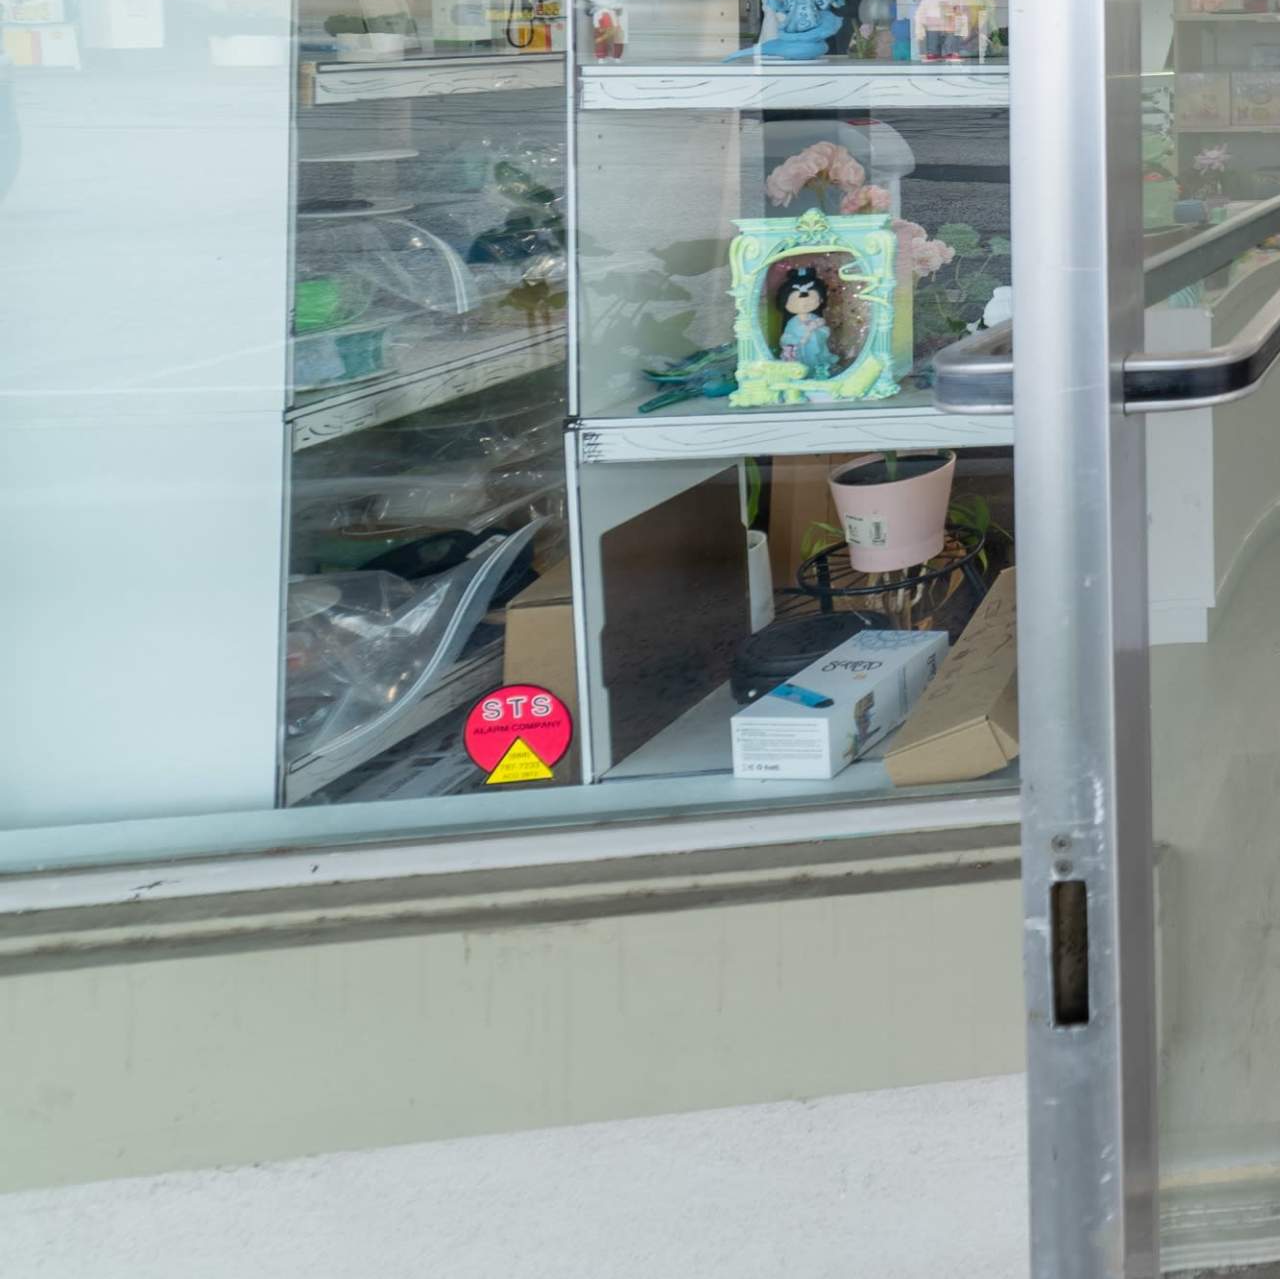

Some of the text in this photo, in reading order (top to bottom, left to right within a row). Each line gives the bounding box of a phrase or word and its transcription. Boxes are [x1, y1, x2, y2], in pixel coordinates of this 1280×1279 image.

[482, 695, 552, 721] STS
[473, 721, 562, 735] ALARM COMPANY
